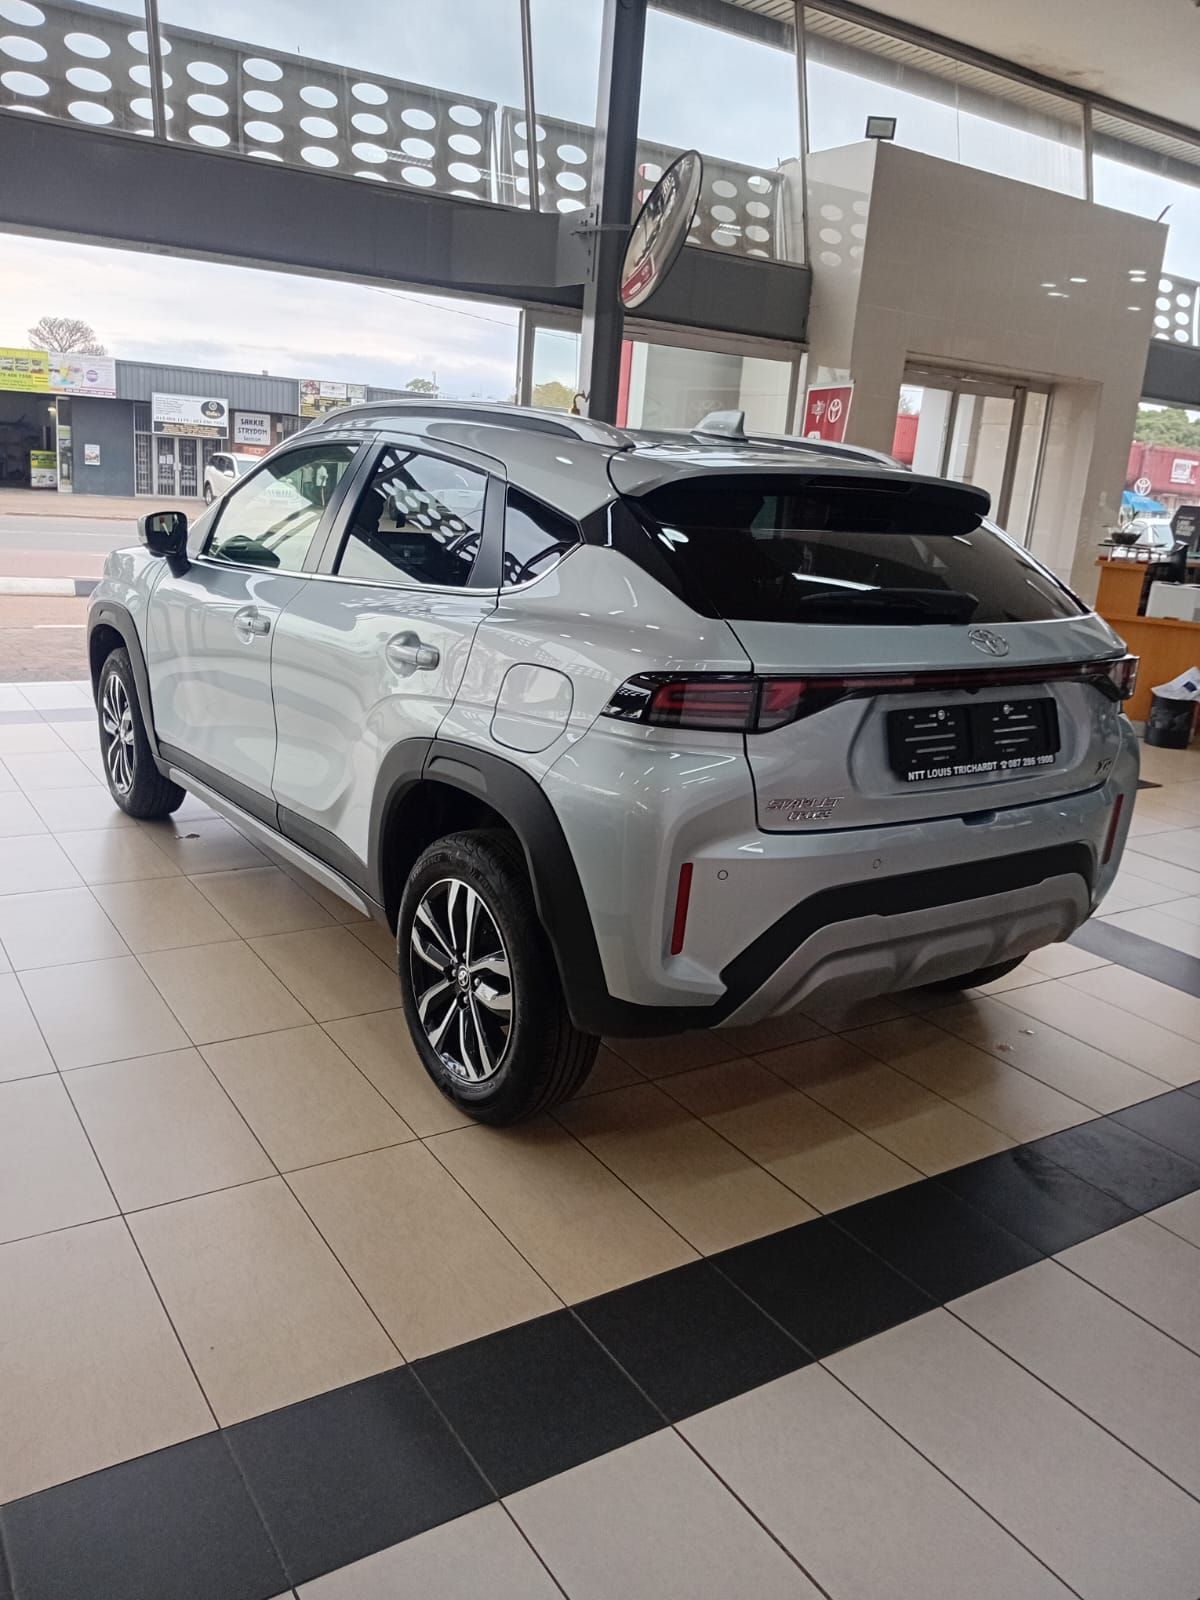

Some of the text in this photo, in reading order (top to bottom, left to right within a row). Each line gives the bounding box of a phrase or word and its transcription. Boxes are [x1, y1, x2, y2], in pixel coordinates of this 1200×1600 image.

[241, 418, 265, 427] SAKKIE
[238, 427, 268, 436] STRYDOM
[908, 770, 925, 781] NTT
[927, 766, 952, 779] LOUIS
[954, 761, 998, 775] TRICHARDT
[766, 796, 845, 811] STARLET
[787, 809, 832, 822] CROSS
